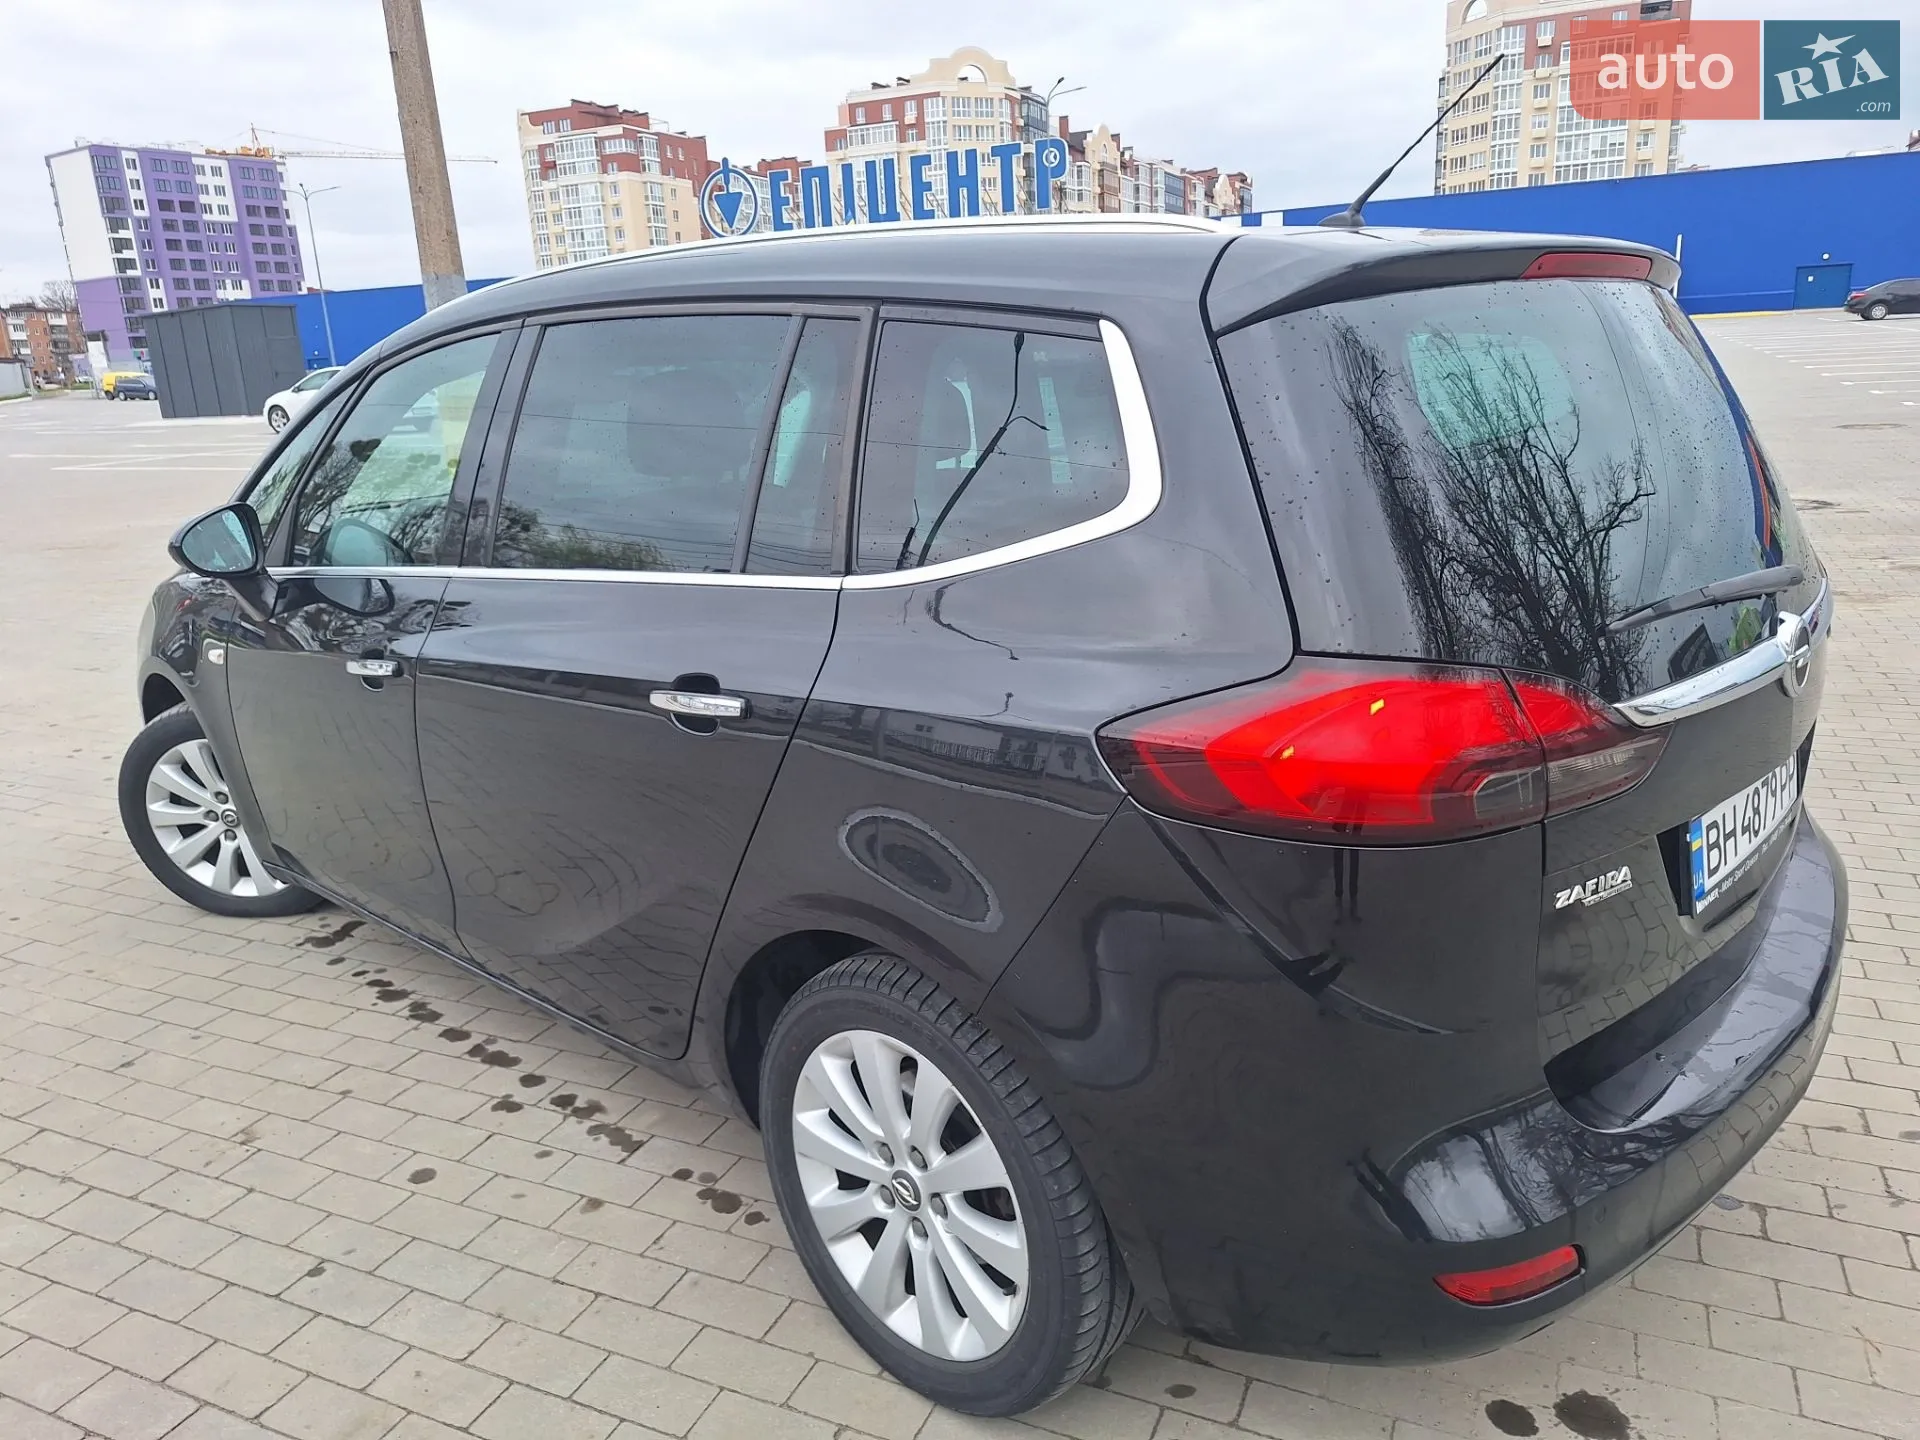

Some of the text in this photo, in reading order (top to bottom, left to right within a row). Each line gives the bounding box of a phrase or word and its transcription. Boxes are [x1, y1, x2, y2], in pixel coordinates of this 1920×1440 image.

[767, 138, 1071, 232] ЕПІЦЕНТР
[1705, 804, 1738, 880] BH
[1741, 771, 1777, 845] 4879
[1780, 753, 1796, 811] PP
[1553, 866, 1633, 910] ZAFIRA
[1693, 868, 1704, 890] UA
